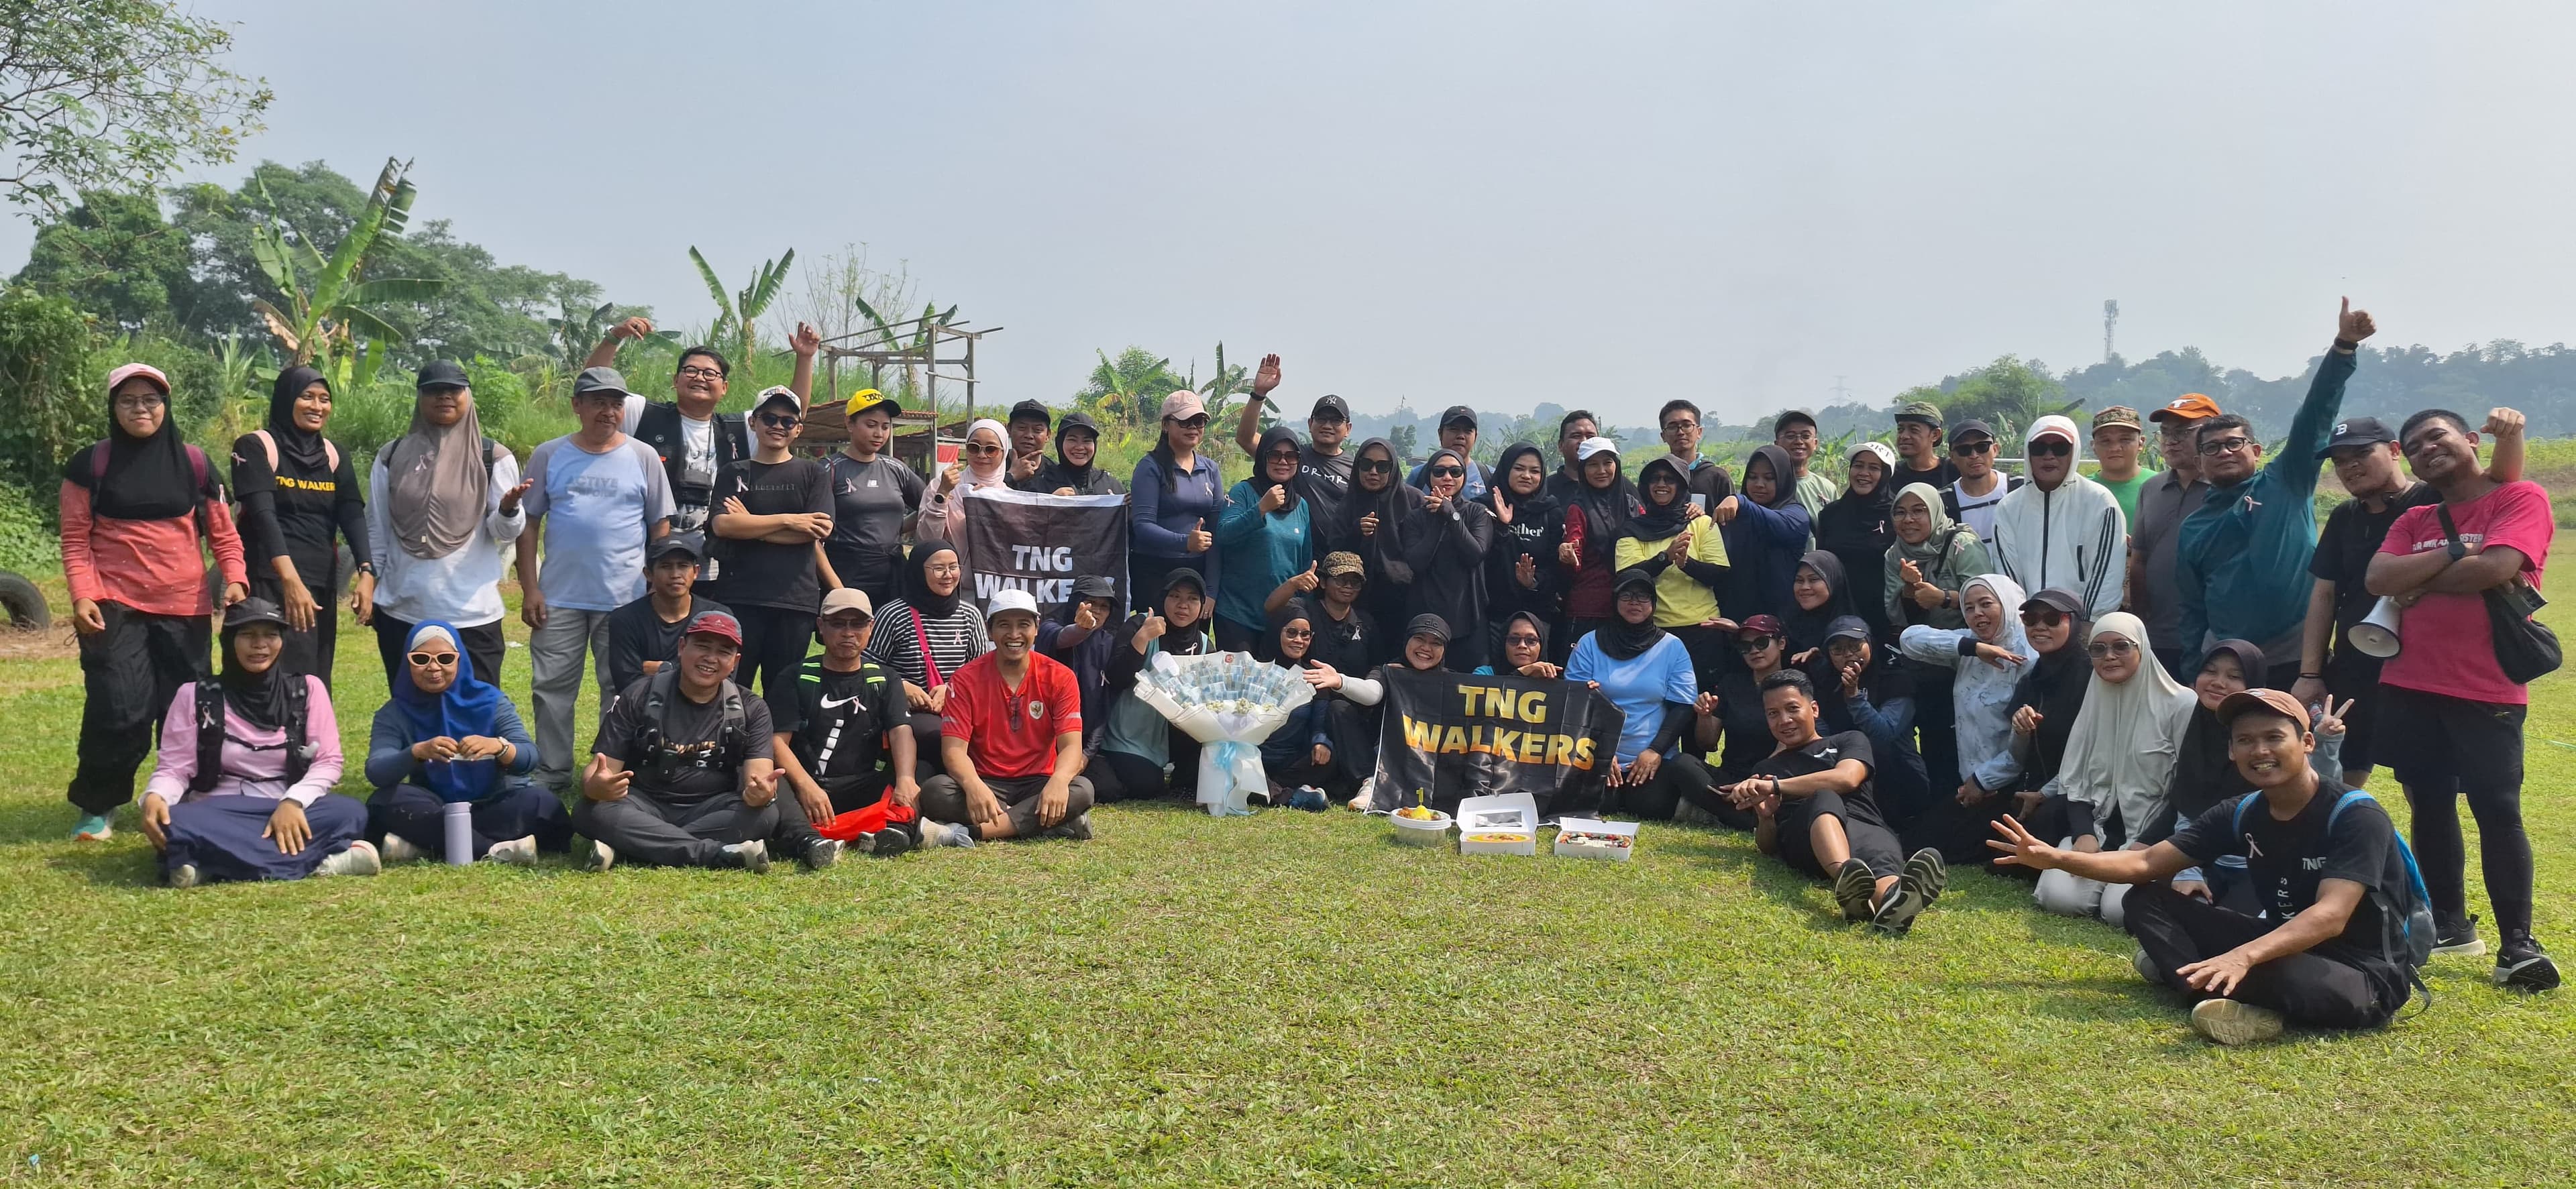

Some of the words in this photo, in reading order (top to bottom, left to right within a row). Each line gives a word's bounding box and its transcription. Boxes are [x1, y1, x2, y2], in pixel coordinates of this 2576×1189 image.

[2335, 423, 2348, 435] B
[1301, 465, 1348, 484] DRMR
[1012, 544, 1073, 572] TNG
[973, 572, 1115, 604] WALKE
[1458, 684, 1547, 724] TNG
[1402, 713, 1598, 771] WALKERS
